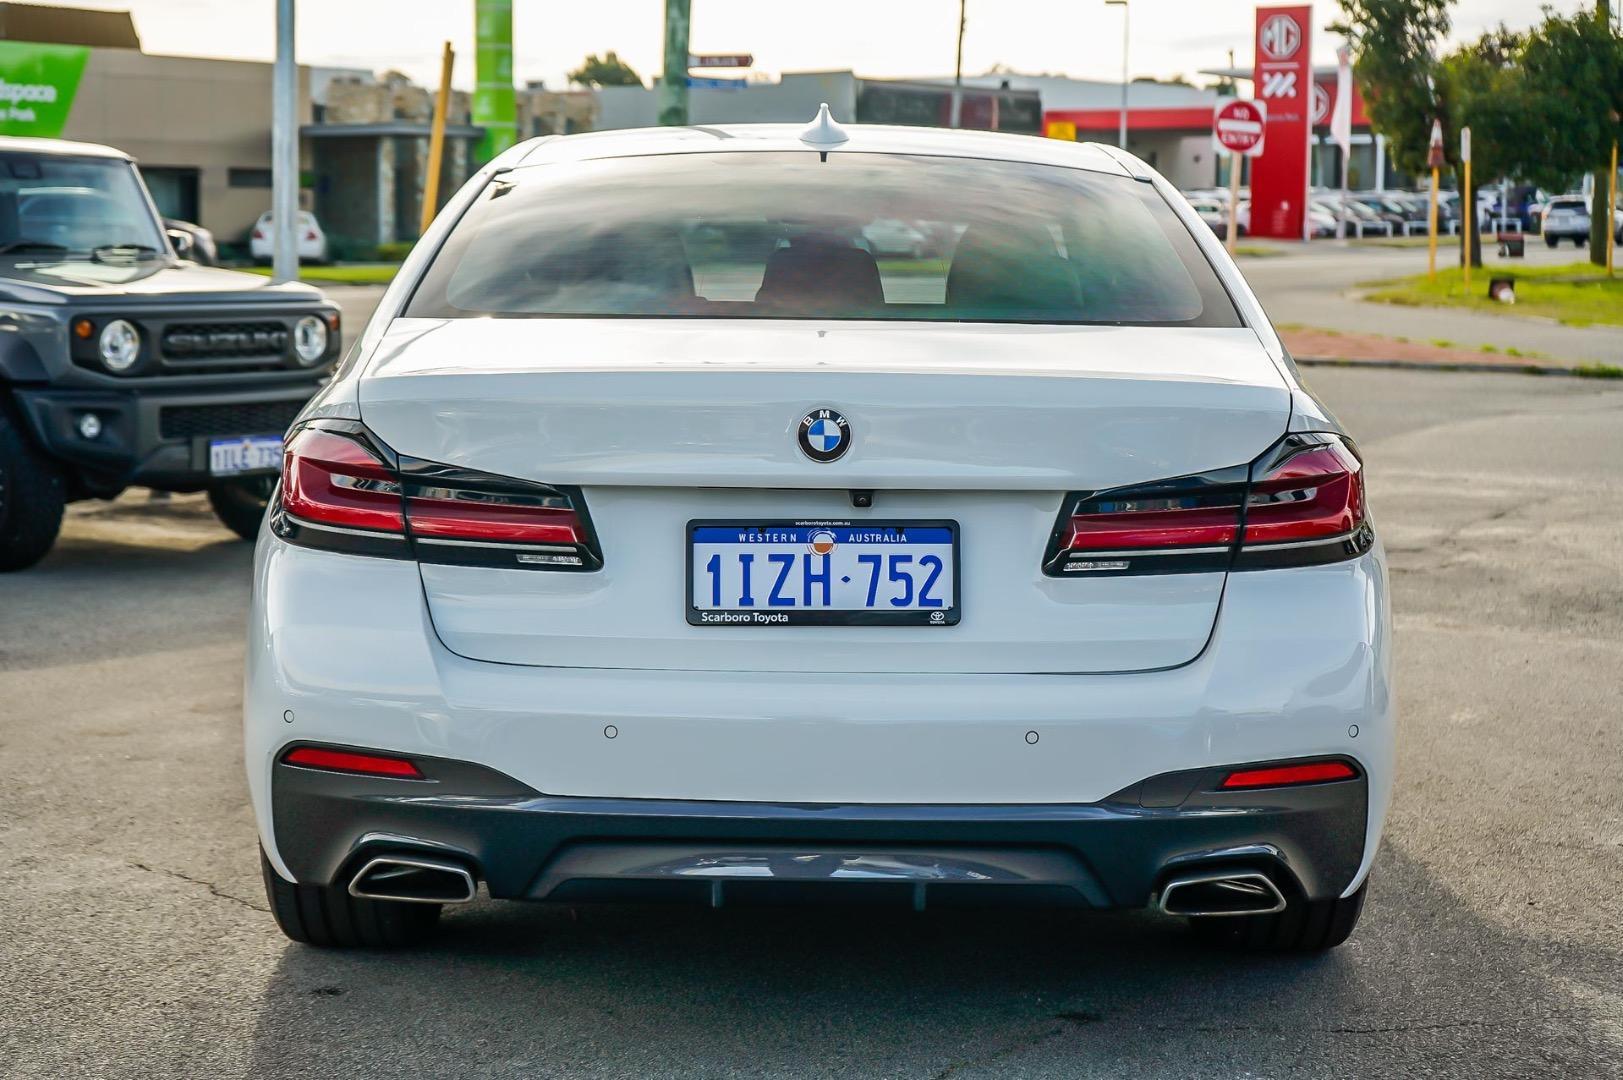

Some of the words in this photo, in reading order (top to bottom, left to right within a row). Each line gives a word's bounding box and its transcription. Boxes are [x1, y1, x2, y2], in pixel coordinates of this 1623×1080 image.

[1262, 16, 1299, 57] MG
[1233, 107, 1250, 120] NO
[1221, 133, 1256, 145] ENTRY
[168, 331, 288, 351] SUZUKI
[803, 410, 847, 427] BMW
[795, 520, 851, 530] scarborotoyota.com.au
[739, 533, 797, 542] WESTERN
[848, 533, 907, 543] AUSTRALIA
[701, 612, 750, 622] Scarboro
[753, 612, 788, 624] Toyota
